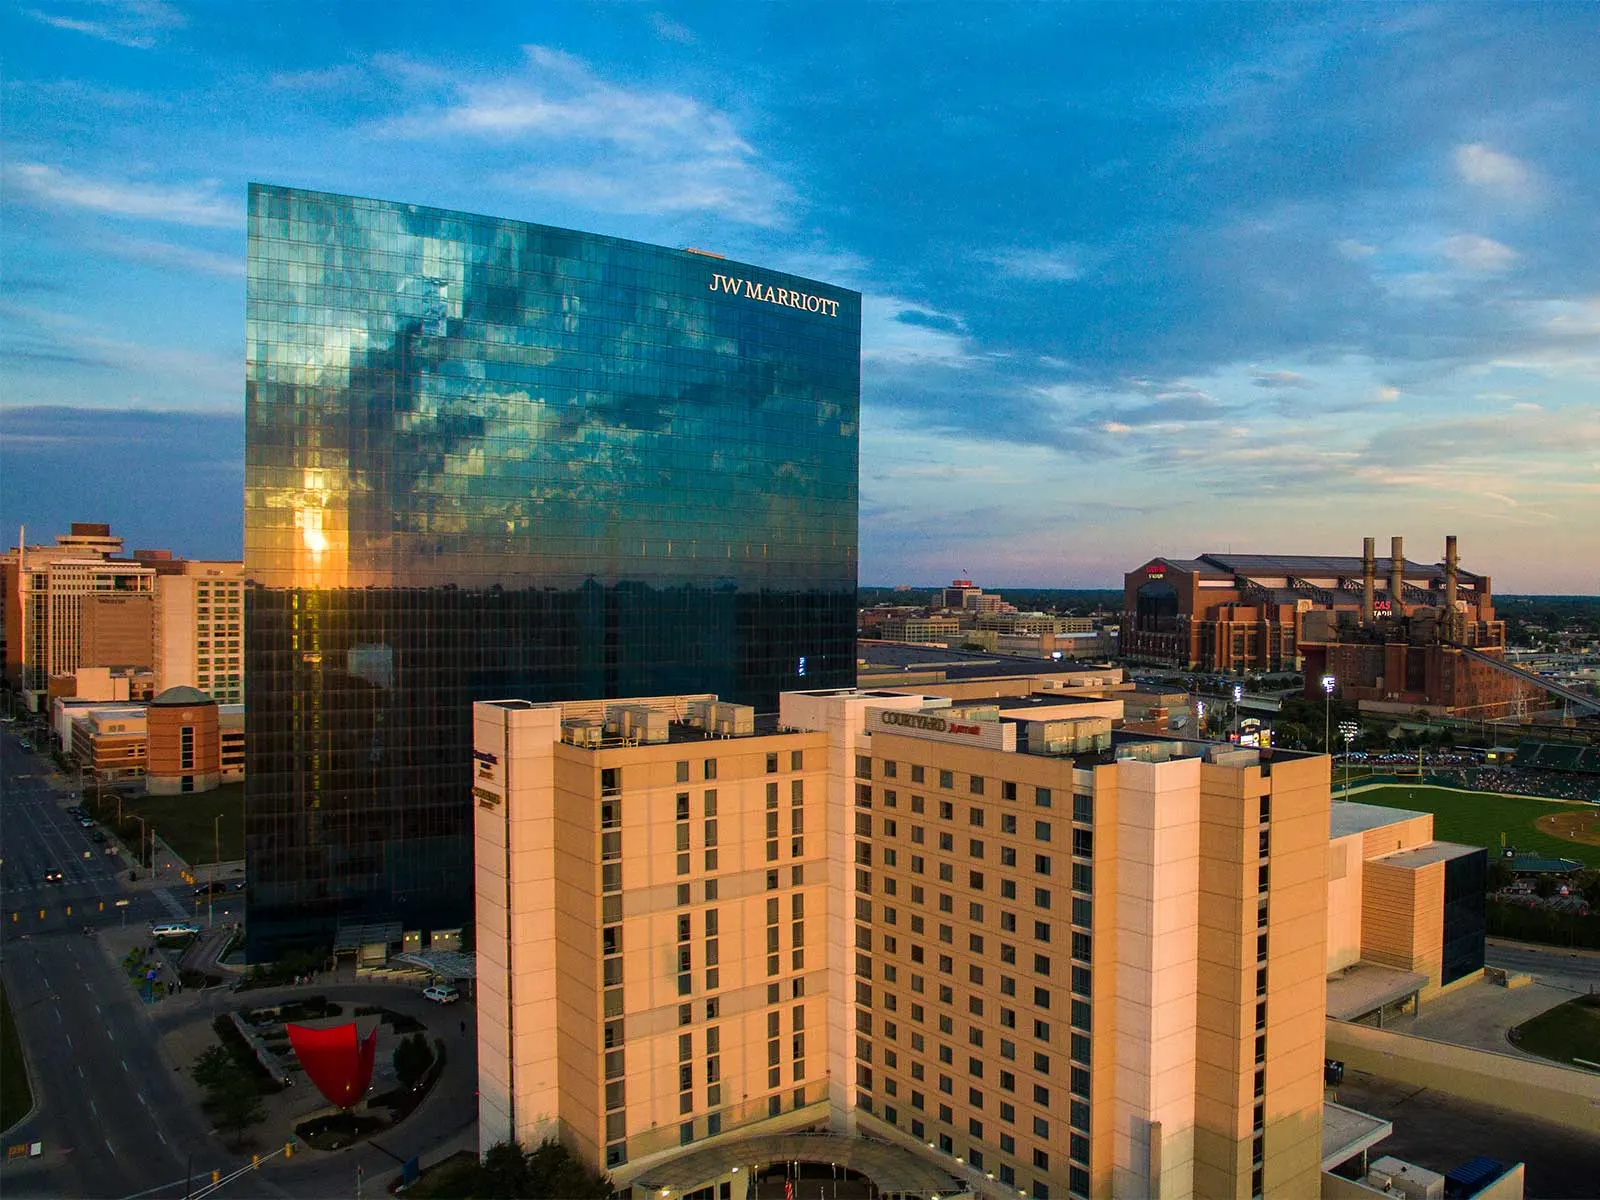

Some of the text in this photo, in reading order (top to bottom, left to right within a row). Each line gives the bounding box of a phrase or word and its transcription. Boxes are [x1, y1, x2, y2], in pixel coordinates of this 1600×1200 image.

[709, 273, 839, 317] JW MARRIOTT
[1374, 601, 1391, 610] CAS
